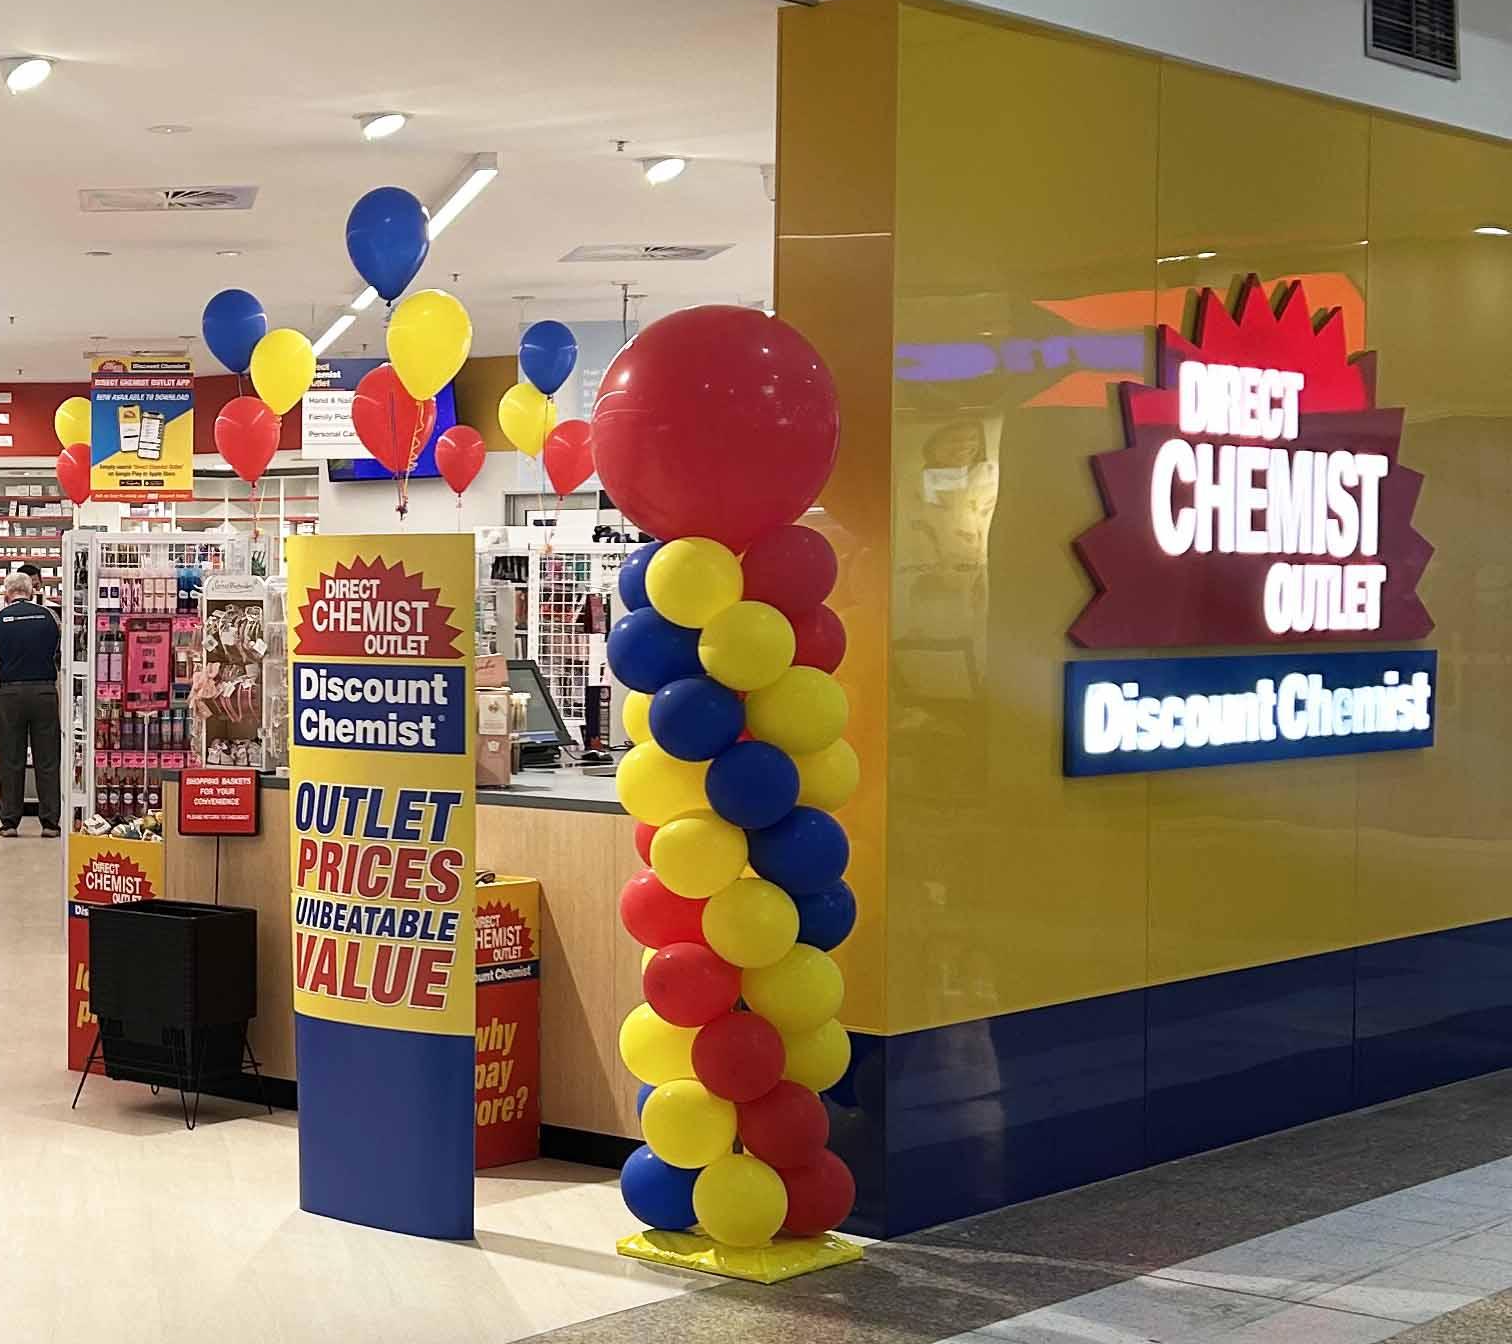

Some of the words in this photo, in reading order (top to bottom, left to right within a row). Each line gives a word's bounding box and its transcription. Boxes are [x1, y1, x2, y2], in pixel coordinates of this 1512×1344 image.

[95, 378, 118, 386] DIRECT
[120, 378, 149, 386] CHEMIST
[176, 378, 191, 386] APP
[1179, 360, 1304, 440] DIRECT
[309, 414, 332, 422] Family
[1150, 439, 1388, 558] CHEMIST
[325, 578, 380, 599] DIRECT
[1263, 562, 1387, 634] OUTLET
[312, 601, 429, 633] CHEMIST
[364, 634, 429, 656] OUTLET
[300, 667, 448, 705] Discount
[1083, 678, 1277, 755] Discount
[1277, 670, 1431, 739] Chemist
[300, 708, 436, 747] Chemist
[186, 777, 219, 785] SHOPPING
[221, 777, 252, 785] BASKETS
[199, 787, 214, 795] FOR
[216, 787, 236, 795] YOUR
[193, 797, 240, 806] CONVENIENCE
[294, 780, 464, 843] OUTLET
[92, 861, 120, 875] DIRECT
[296, 837, 465, 905] PRICES
[85, 872, 142, 895] CHEMIST
[294, 896, 460, 943] UNBEATABLE
[475, 925, 522, 950] HEMIST
[493, 946, 522, 962] OUTLET
[294, 931, 456, 1011] VALUE
[495, 964, 531, 981] Chemist
[475, 1086, 529, 1127] ore?
